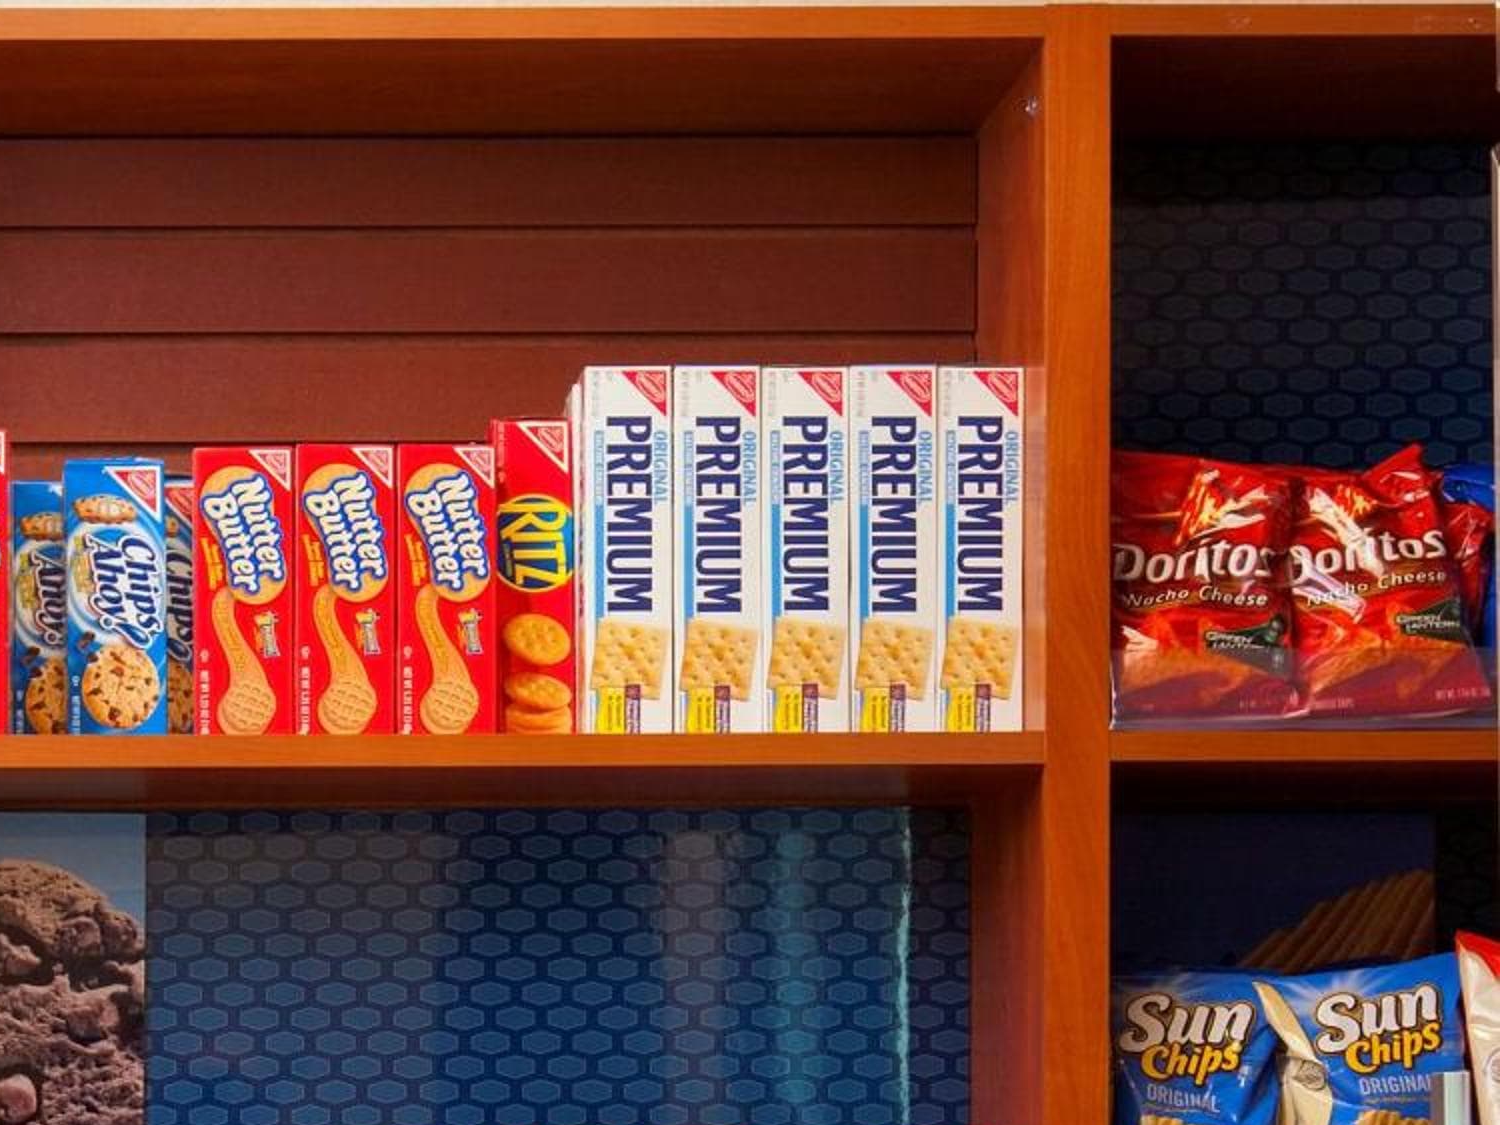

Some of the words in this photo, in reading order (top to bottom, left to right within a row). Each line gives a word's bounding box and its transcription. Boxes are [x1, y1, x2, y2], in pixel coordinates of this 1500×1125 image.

[653, 430, 668, 504] ORIGINAL
[744, 430, 757, 503] ORIGINAL
[831, 430, 844, 503] ORIGINAL
[920, 430, 933, 503] ORIGINAL
[1005, 430, 1019, 504] ORIGINAL
[204, 493, 258, 595] Butter
[233, 475, 282, 580] Nutter
[304, 490, 362, 591] Butter
[334, 473, 384, 578] Nutter
[406, 491, 464, 591] Butter
[435, 473, 486, 579] Nutter
[499, 501, 572, 586] RITZ
[606, 415, 653, 613] PREMIUM
[695, 415, 742, 613] PREMIUM
[783, 415, 830, 612] PREMIUM
[871, 415, 917, 613] PREMIUM
[957, 415, 1003, 612] PREMIUM
[85, 534, 153, 648] Ahoy!
[118, 536, 163, 634] Chips
[1113, 538, 1275, 583] Doritos
[1288, 527, 1447, 581] Doritos
[1377, 572, 1447, 590] Cheese
[1126, 588, 1190, 609] Nacho
[1199, 585, 1269, 607] Cheese
[1120, 993, 1256, 1054] Sun
[1316, 985, 1439, 1054] Sun
[1345, 1022, 1442, 1075] Chips
[1140, 1041, 1242, 1084] Chips
[1146, 1083, 1222, 1113] ORIGINAL
